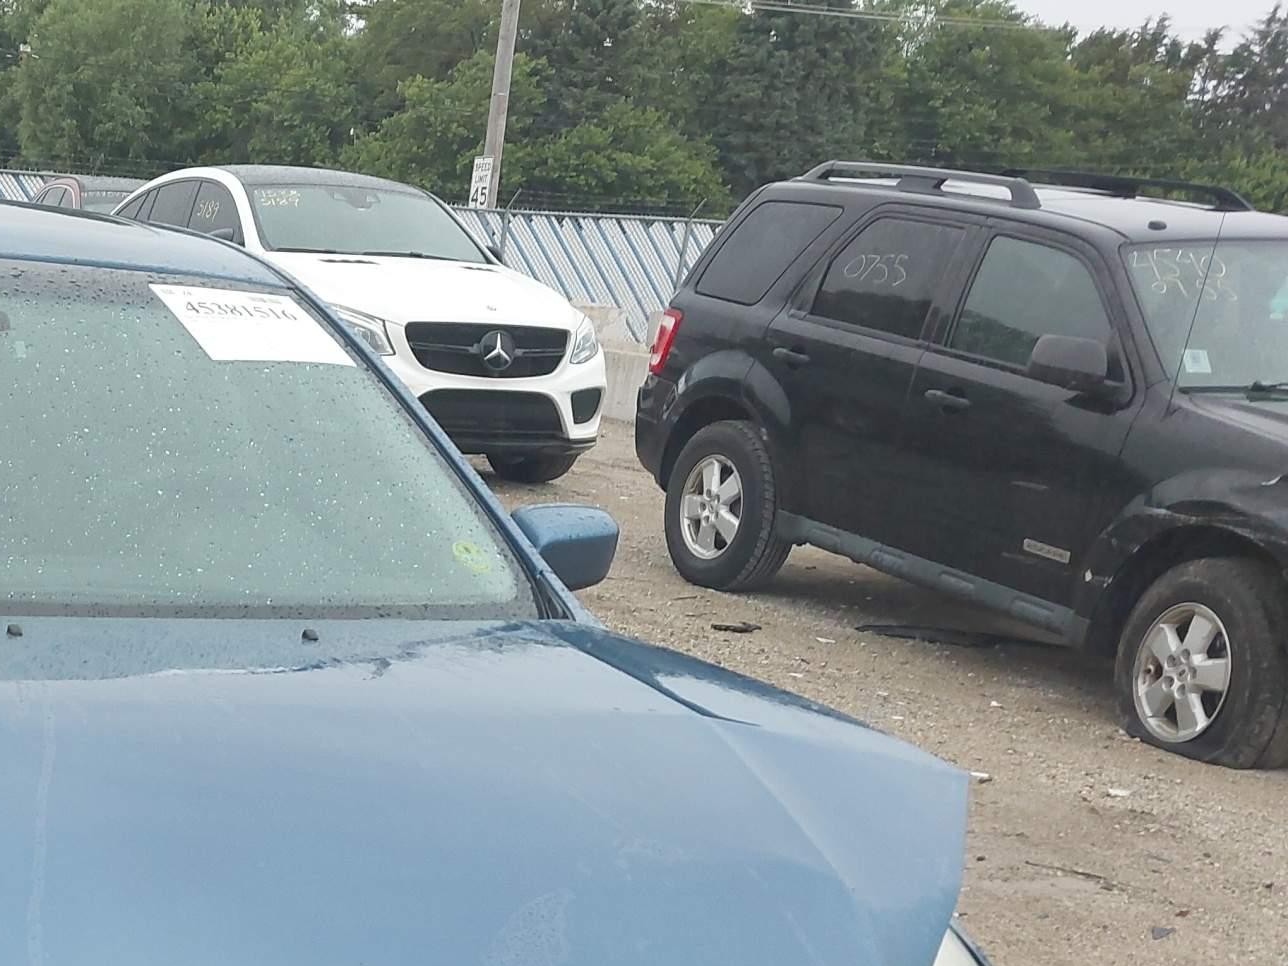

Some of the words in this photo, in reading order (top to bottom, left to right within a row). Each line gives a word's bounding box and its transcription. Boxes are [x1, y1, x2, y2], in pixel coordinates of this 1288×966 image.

[471, 186, 487, 207] 45
[844, 254, 909, 287] 0755
[184, 301, 298, 321] 45381516
